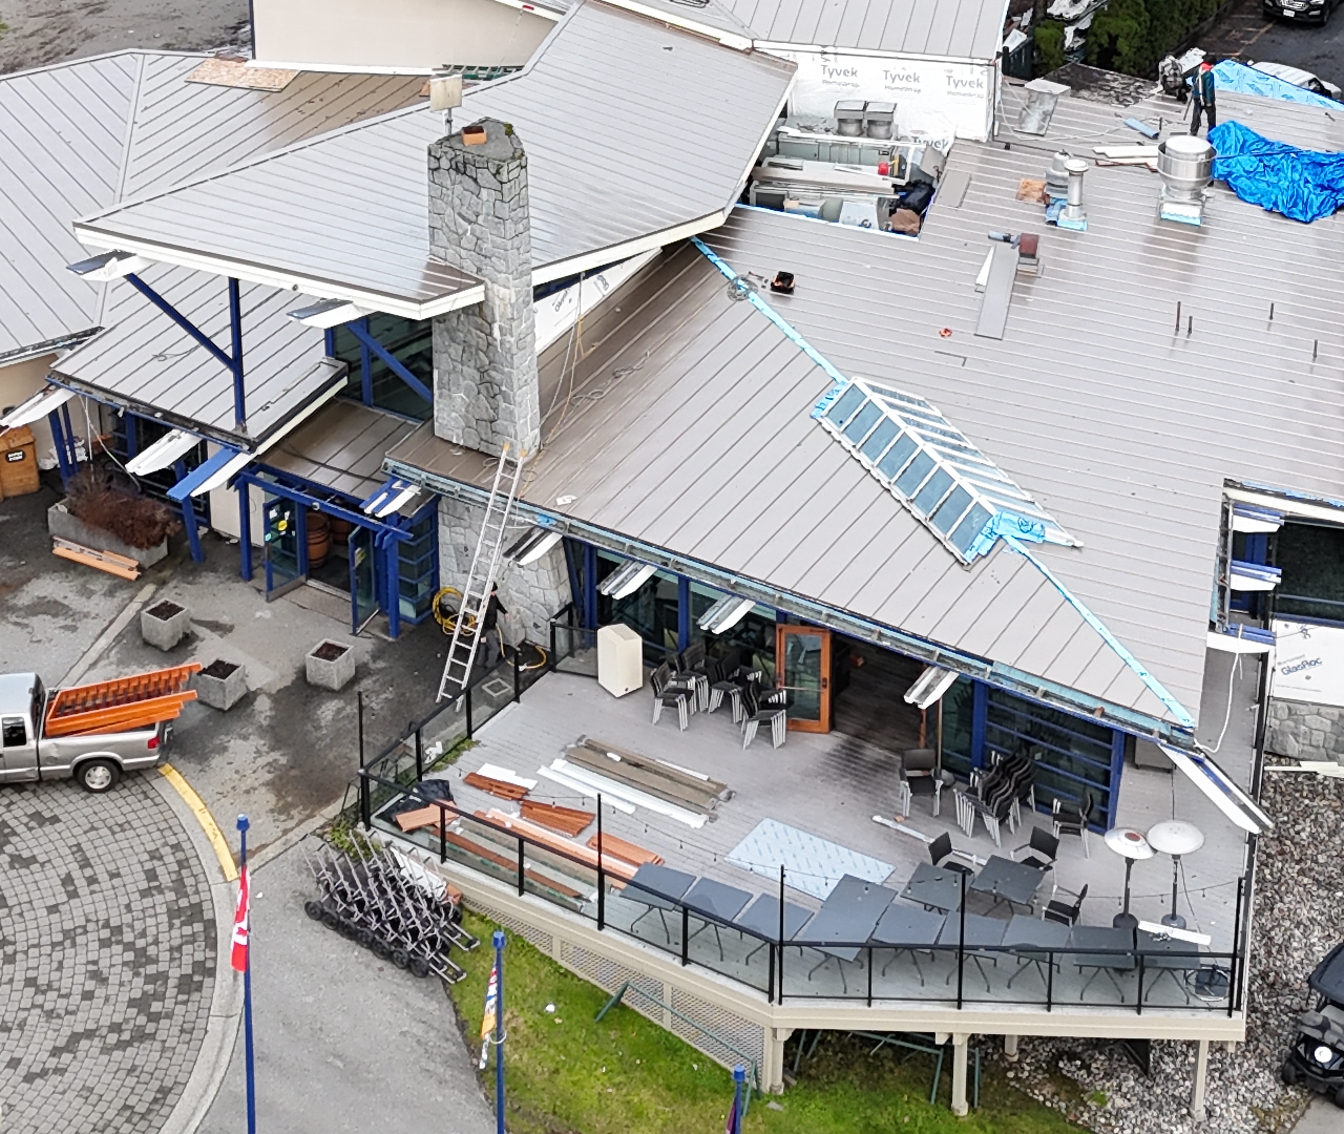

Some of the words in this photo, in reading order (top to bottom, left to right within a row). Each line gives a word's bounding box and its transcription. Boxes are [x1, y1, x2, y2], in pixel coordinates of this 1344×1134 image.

[821, 65, 858, 79] Tyvek
[883, 70, 921, 83] Tyvek
[946, 75, 984, 89] Tyvek
